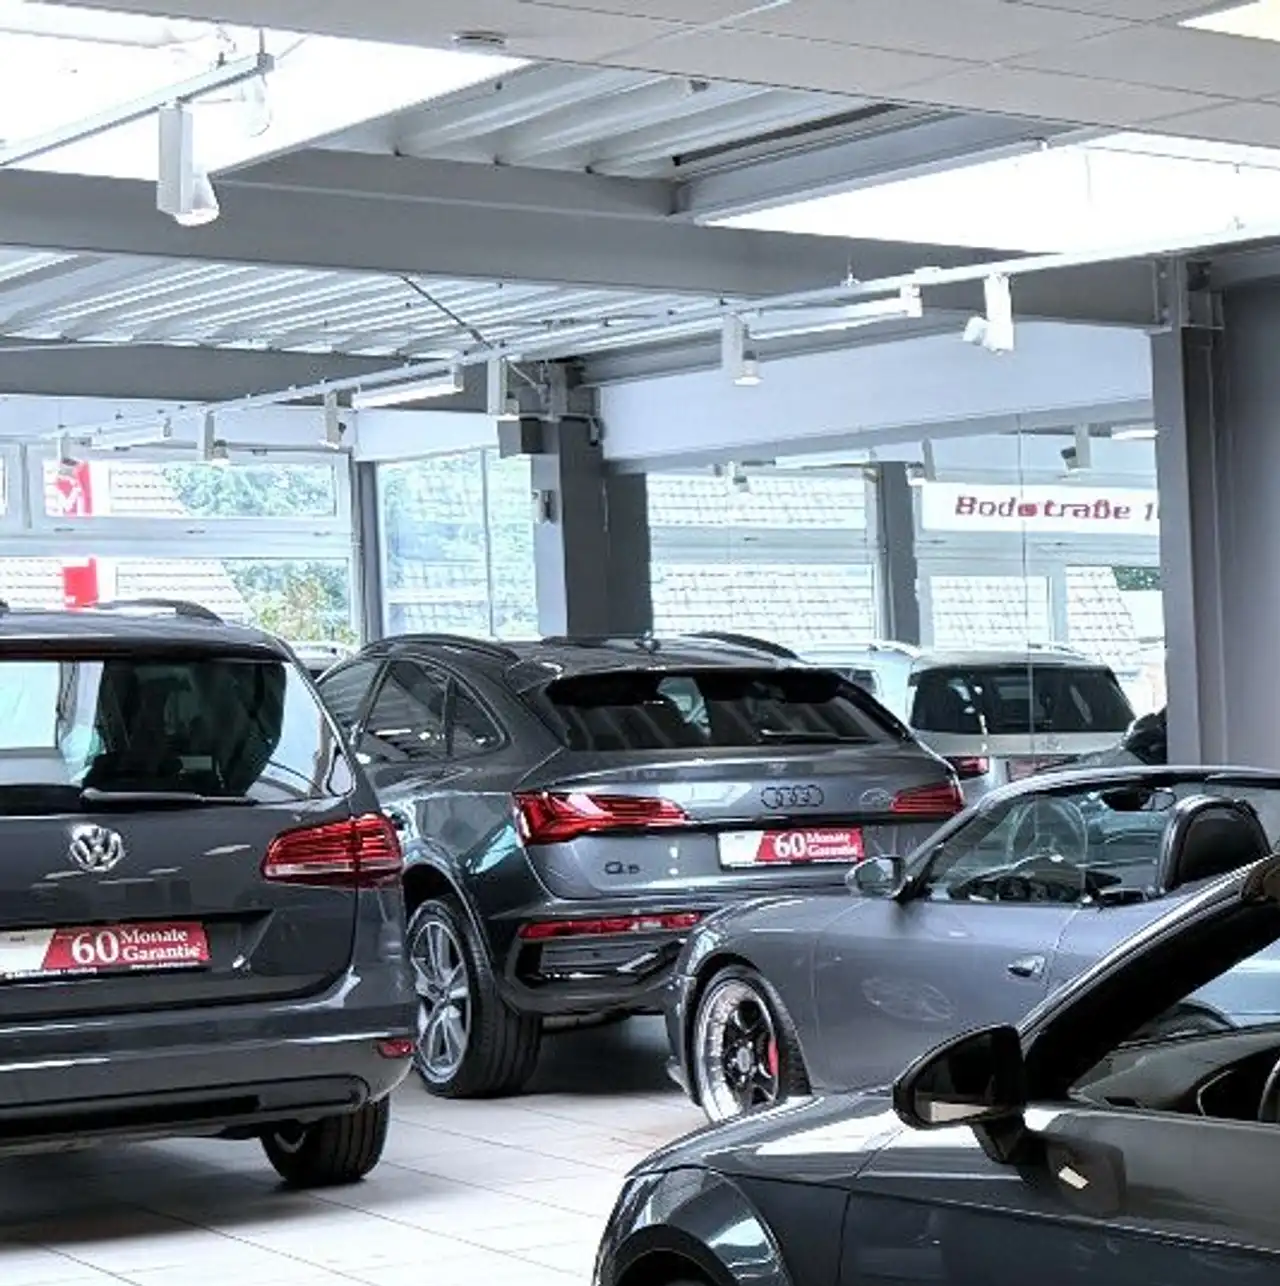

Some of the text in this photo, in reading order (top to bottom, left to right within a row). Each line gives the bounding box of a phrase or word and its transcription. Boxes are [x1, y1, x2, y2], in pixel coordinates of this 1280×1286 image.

[773, 832, 806, 859] 60
[72, 931, 119, 964] 60
[120, 928, 188, 945] Monate
